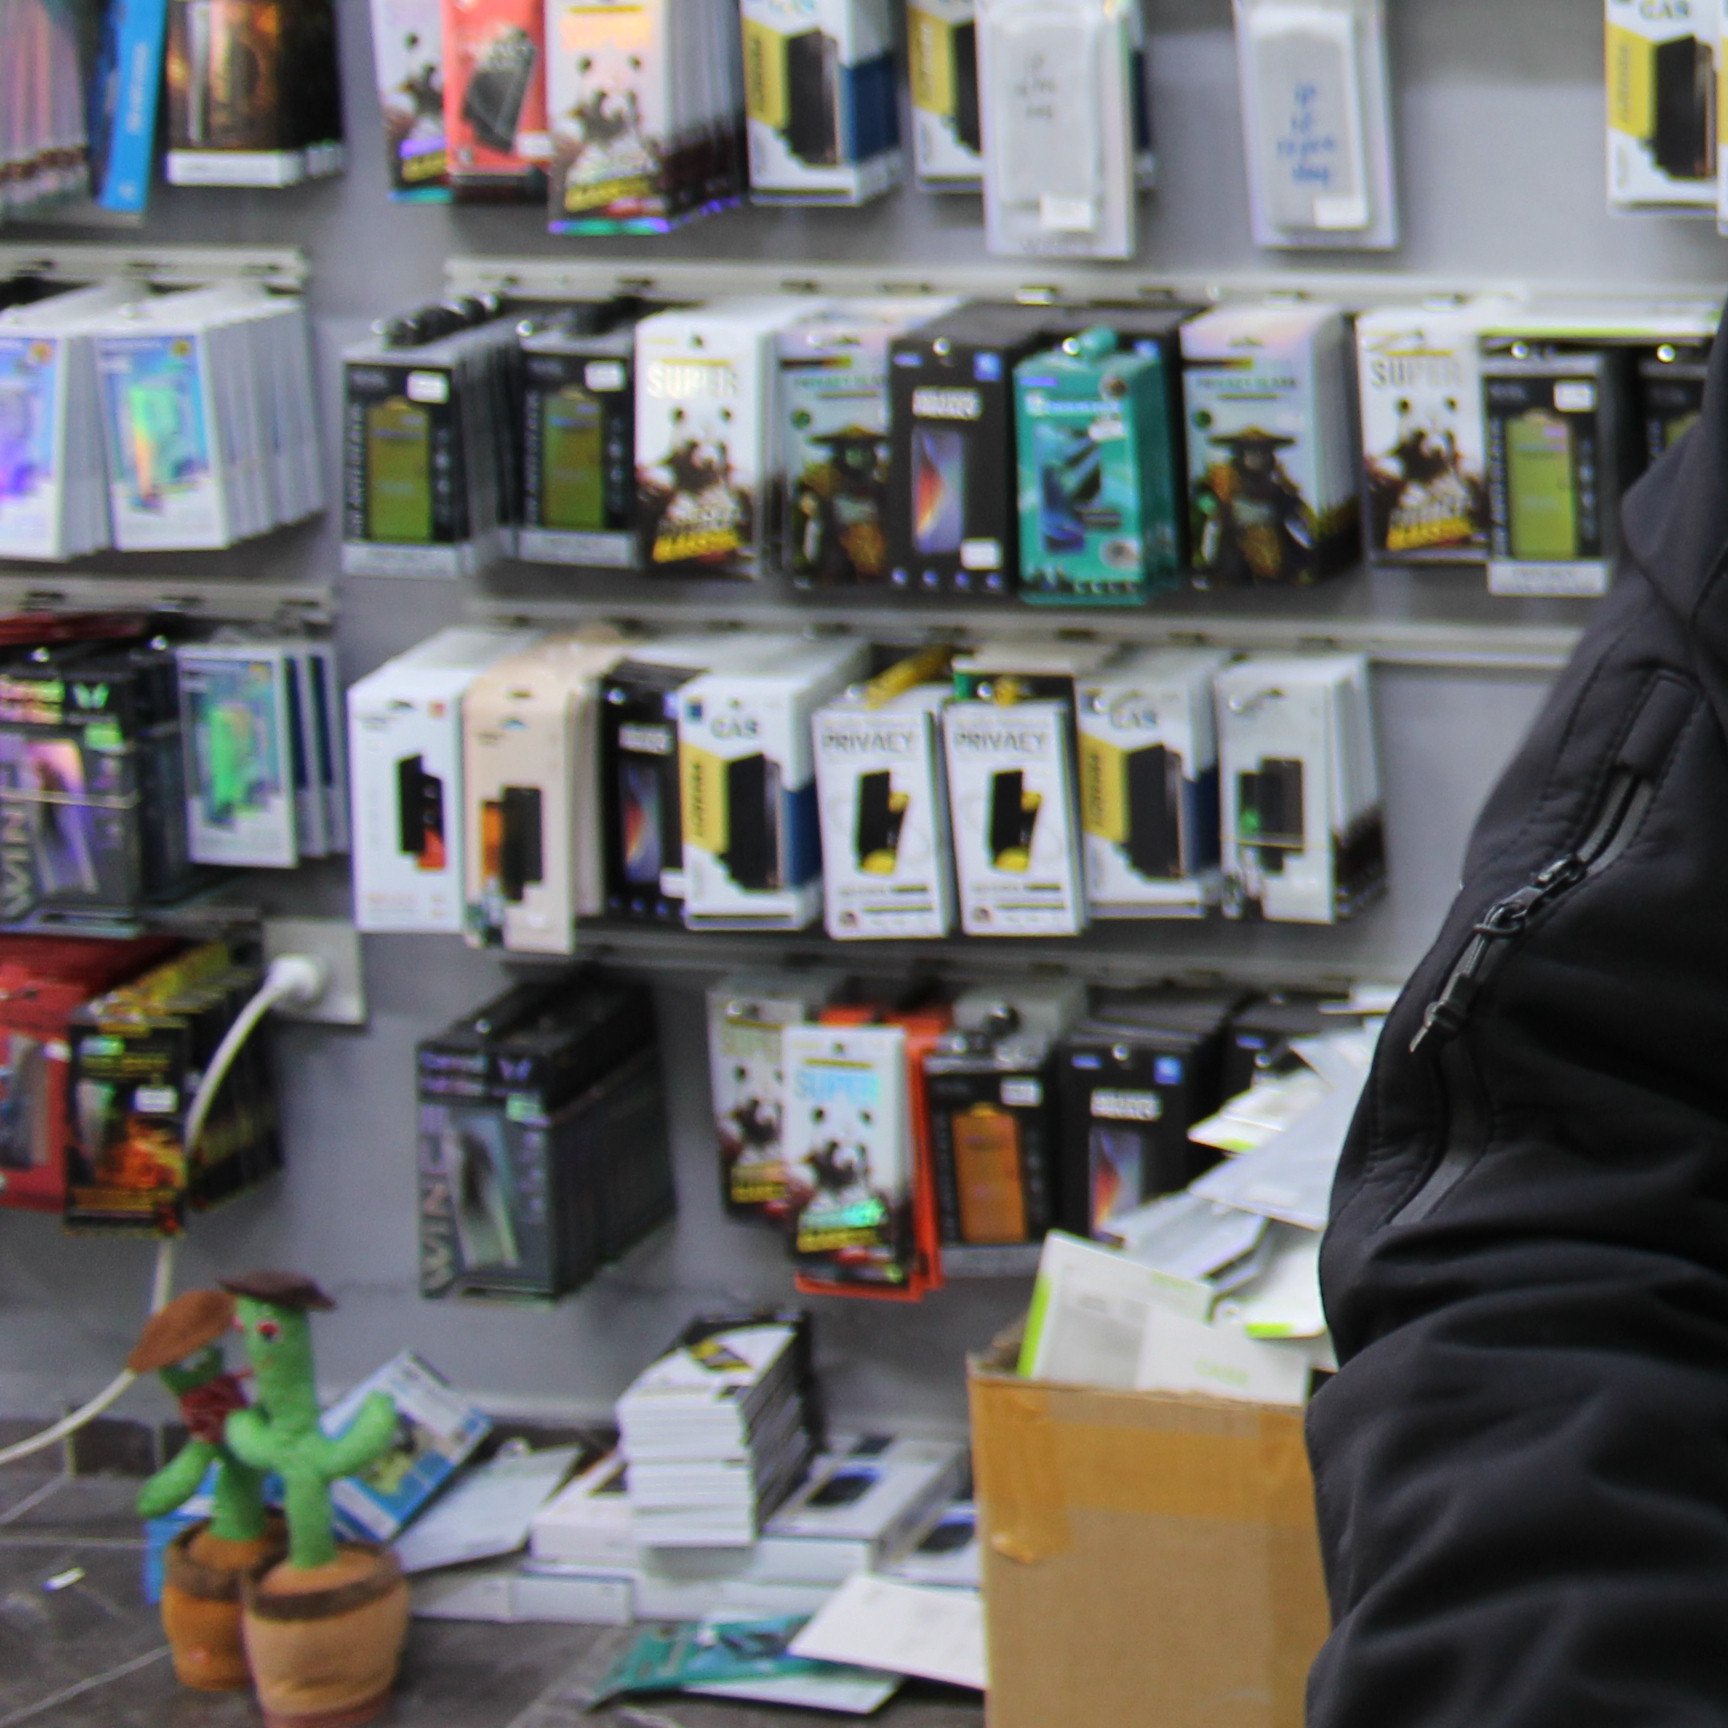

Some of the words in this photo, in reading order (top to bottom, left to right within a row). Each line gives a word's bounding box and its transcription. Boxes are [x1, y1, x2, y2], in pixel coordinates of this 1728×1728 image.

[645, 363, 741, 400] SUPER
[1371, 359, 1464, 389] SUPER
[823, 730, 916, 753] PRIVACY
[955, 728, 1047, 753] PRIVACY
[796, 1071, 882, 1105] SUPER
